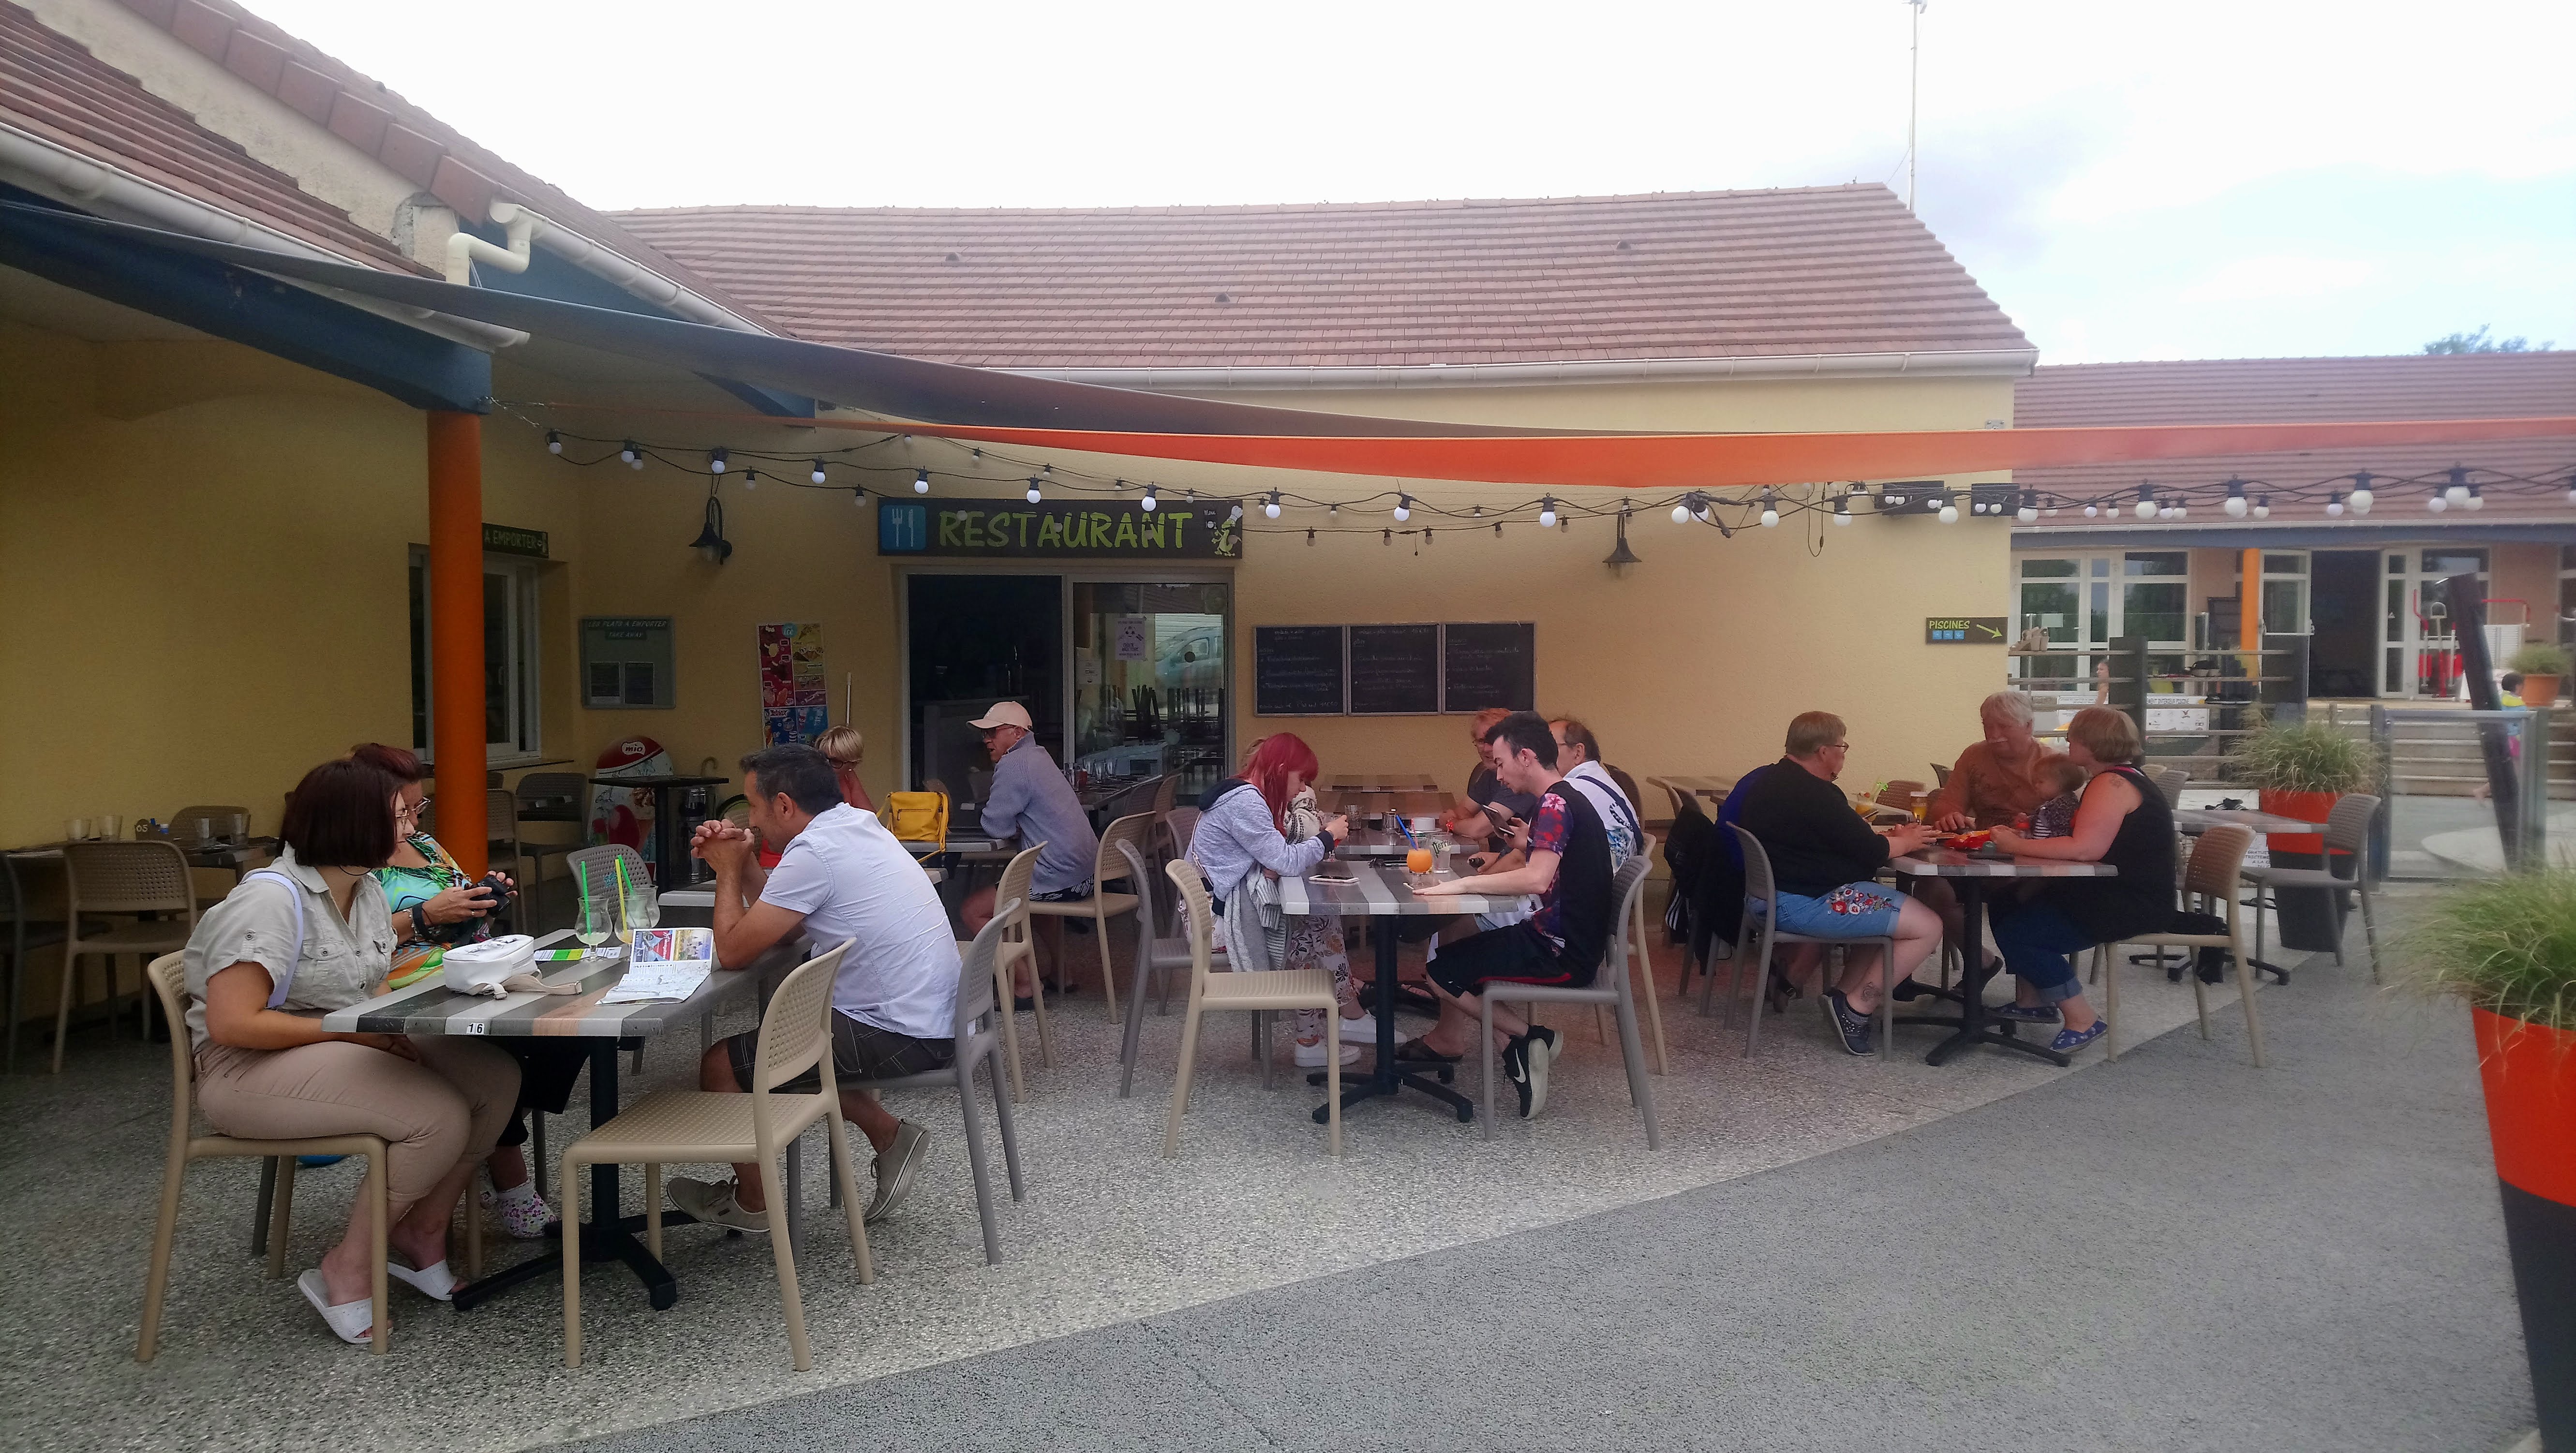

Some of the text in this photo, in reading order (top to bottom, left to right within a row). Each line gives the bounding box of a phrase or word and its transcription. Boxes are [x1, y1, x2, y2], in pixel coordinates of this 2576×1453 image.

[939, 511, 1193, 548] RESTAURANT
[492, 530, 536, 549] EMPORTER
[1929, 620, 1970, 629] PISCINES
[625, 743, 643, 752] mio
[1432, 840, 1451, 858] Perrie
[469, 1023, 483, 1033] 16
